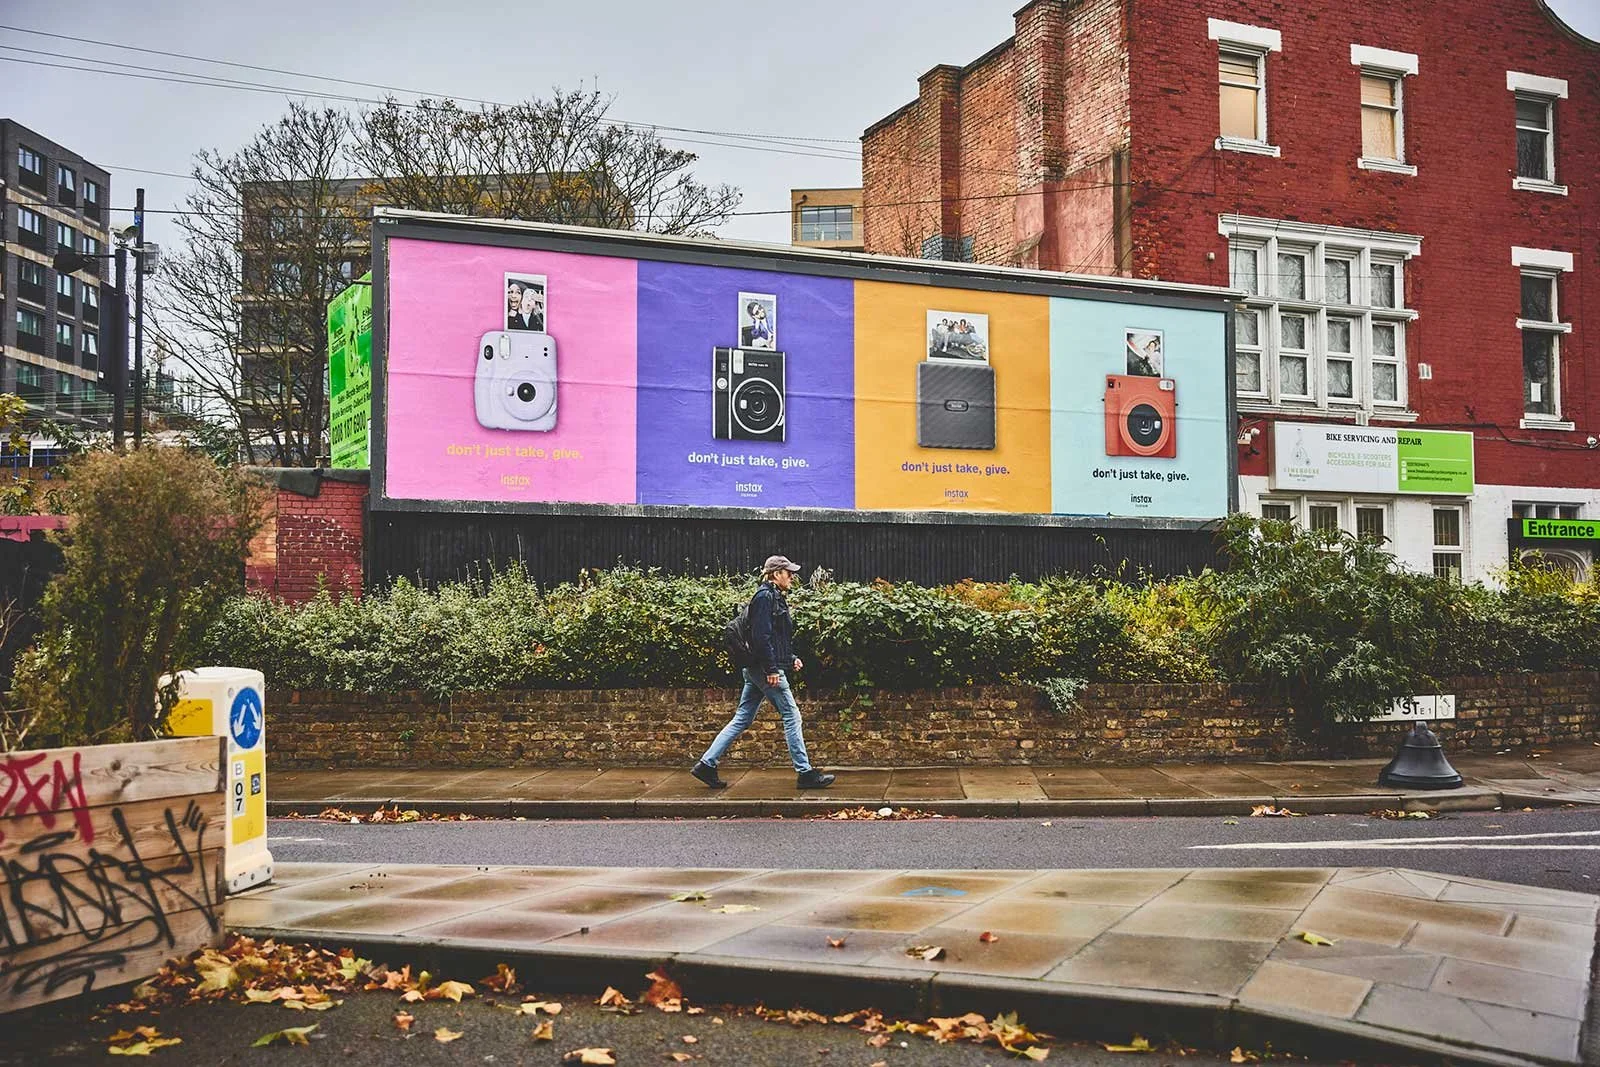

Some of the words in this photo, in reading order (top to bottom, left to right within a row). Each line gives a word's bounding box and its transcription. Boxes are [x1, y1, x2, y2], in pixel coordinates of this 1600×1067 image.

[1325, 432, 1341, 441] BIKE
[1343, 433, 1380, 444] SERVICING
[1381, 436, 1397, 445] AND
[1398, 437, 1422, 446] REPAIR
[447, 444, 481, 456] don't
[485, 445, 512, 459] just
[515, 445, 549, 460] take,
[553, 447, 584, 461] give.
[688, 452, 719, 464] don't
[721, 453, 745, 467] just
[748, 455, 778, 468] take,
[781, 456, 810, 469] give.
[1327, 459, 1365, 467] ACCESSORIES
[901, 461, 929, 472] don't
[931, 462, 953, 474] just
[955, 463, 982, 475] take,
[985, 464, 1010, 476] give.
[1092, 467, 1117, 478] don't
[1119, 468, 1138, 480] just
[1140, 469, 1165, 482] take,
[1167, 470, 1190, 482] give.
[500, 473, 530, 486] instax
[735, 481, 763, 493] instax
[944, 488, 969, 498] instax
[1130, 493, 1152, 503] instax
[1528, 521, 1595, 537] Entrance
